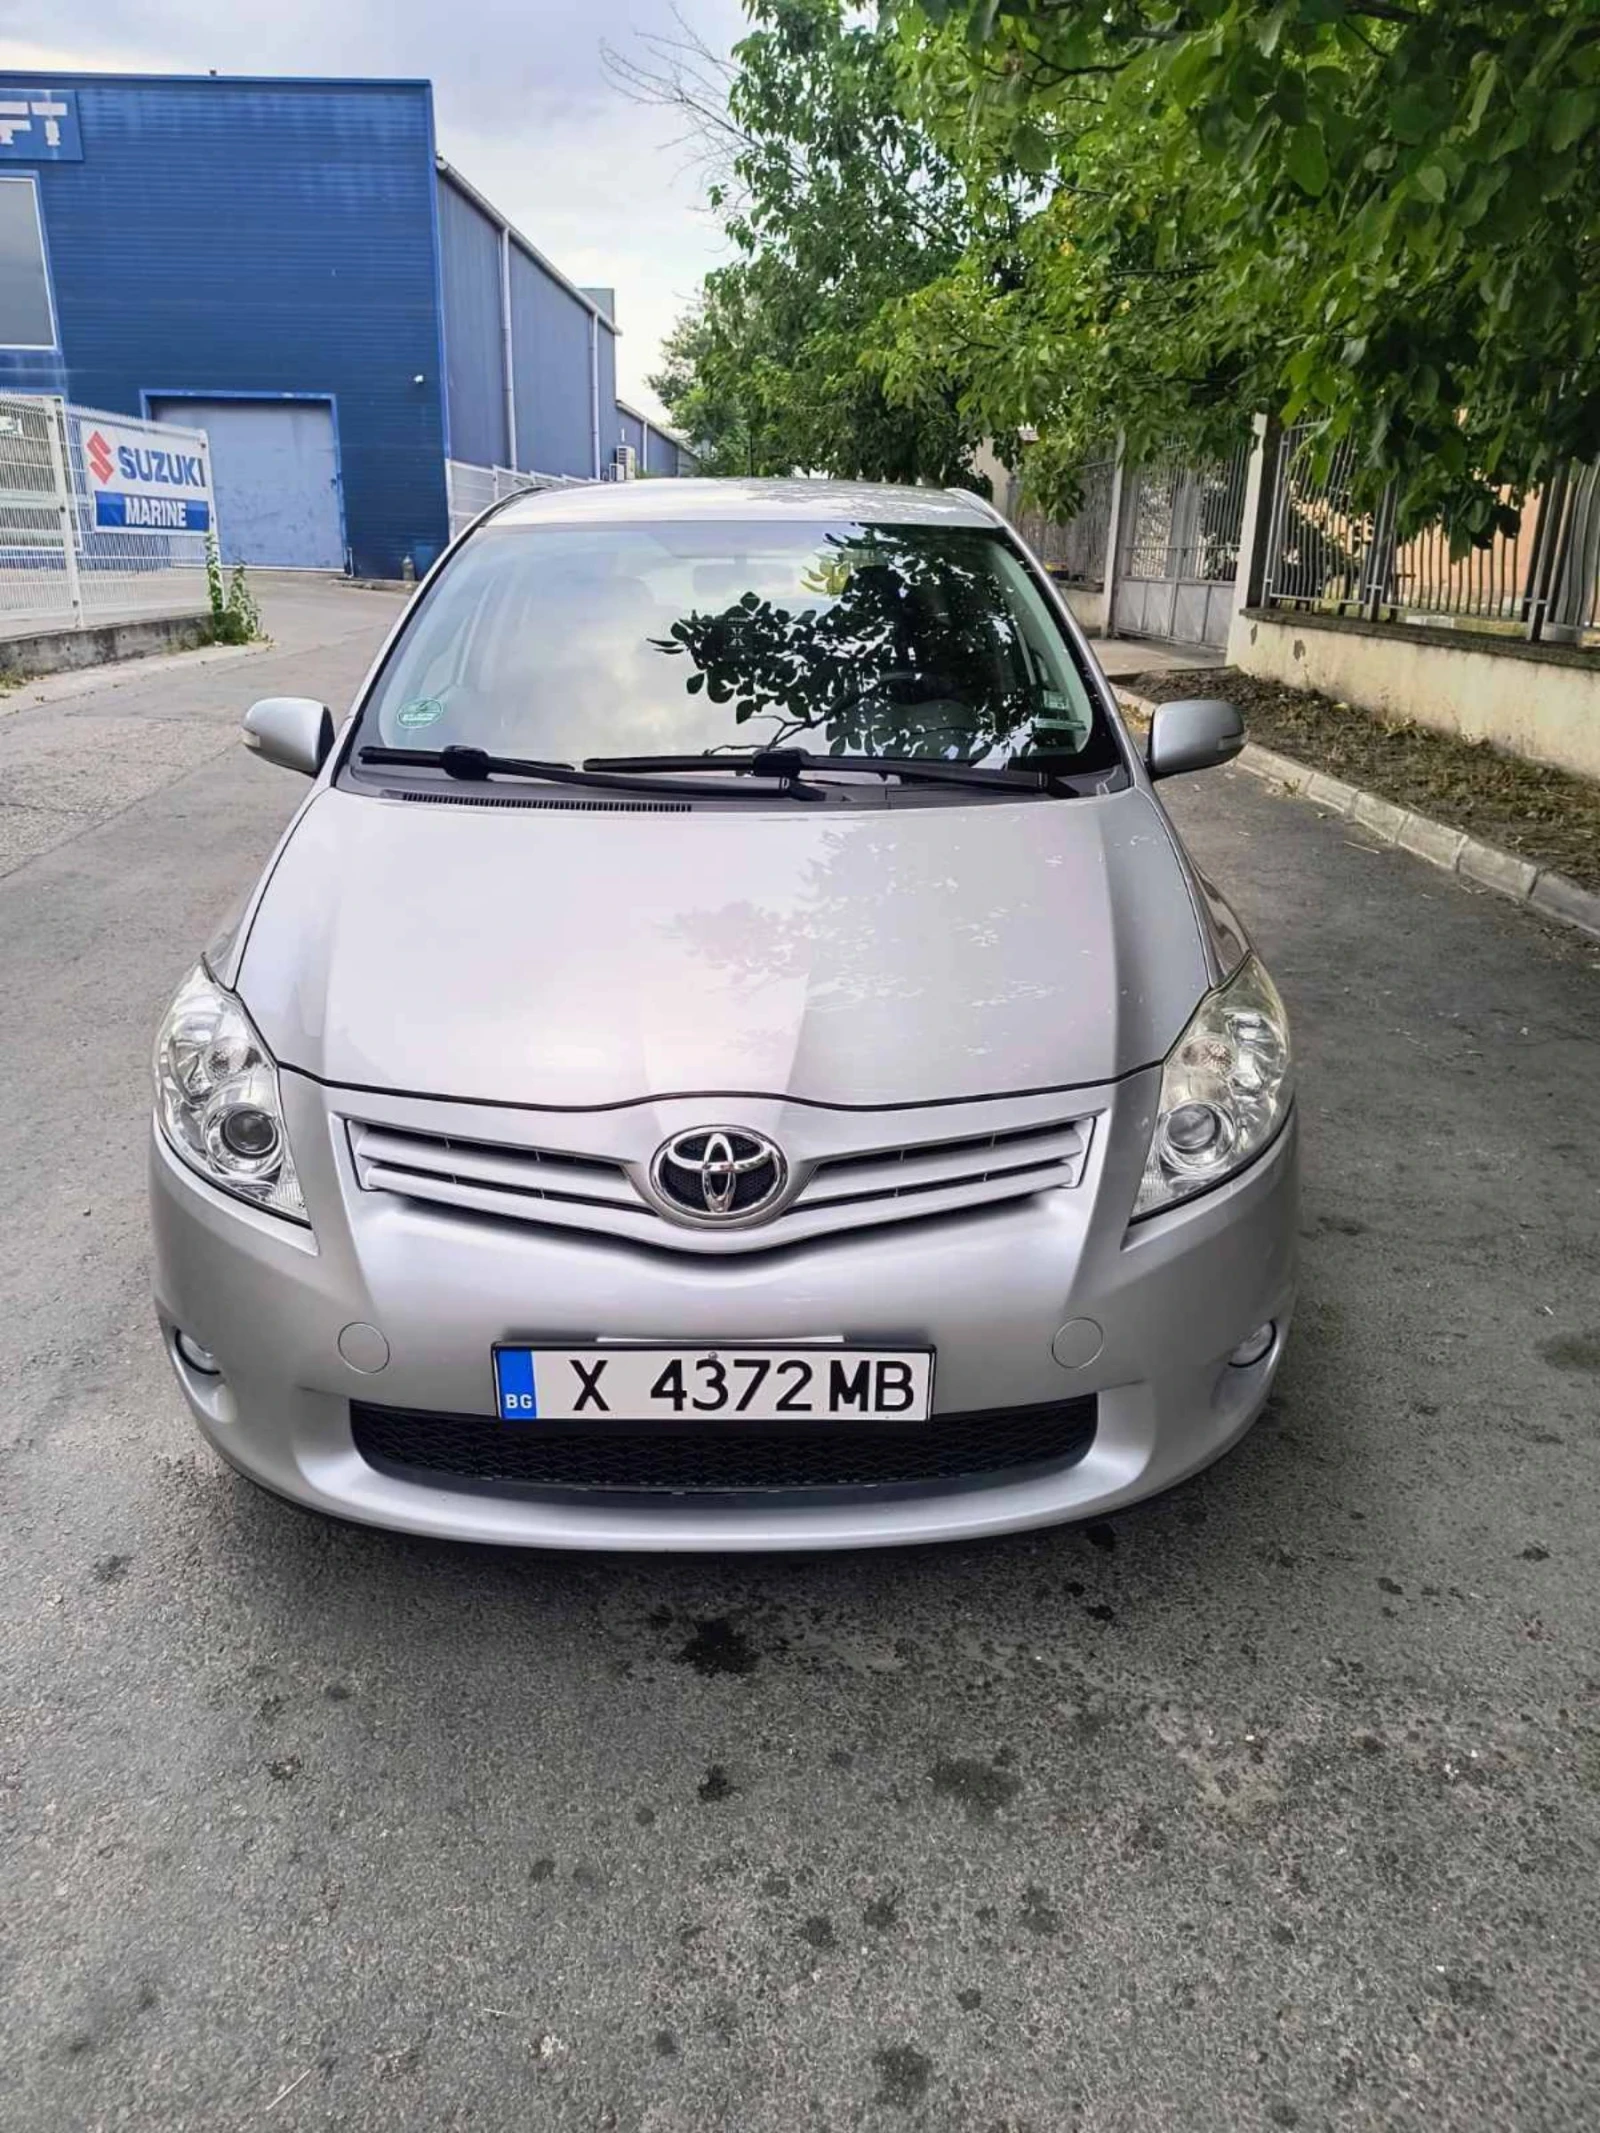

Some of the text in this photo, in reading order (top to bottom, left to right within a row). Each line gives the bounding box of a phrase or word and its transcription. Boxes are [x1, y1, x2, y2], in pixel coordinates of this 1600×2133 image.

[118, 445, 206, 488] SUZUKI
[125, 496, 187, 528] MARINE
[505, 1393, 533, 1410] BG
[569, 1358, 914, 1412] X 4372 MB
